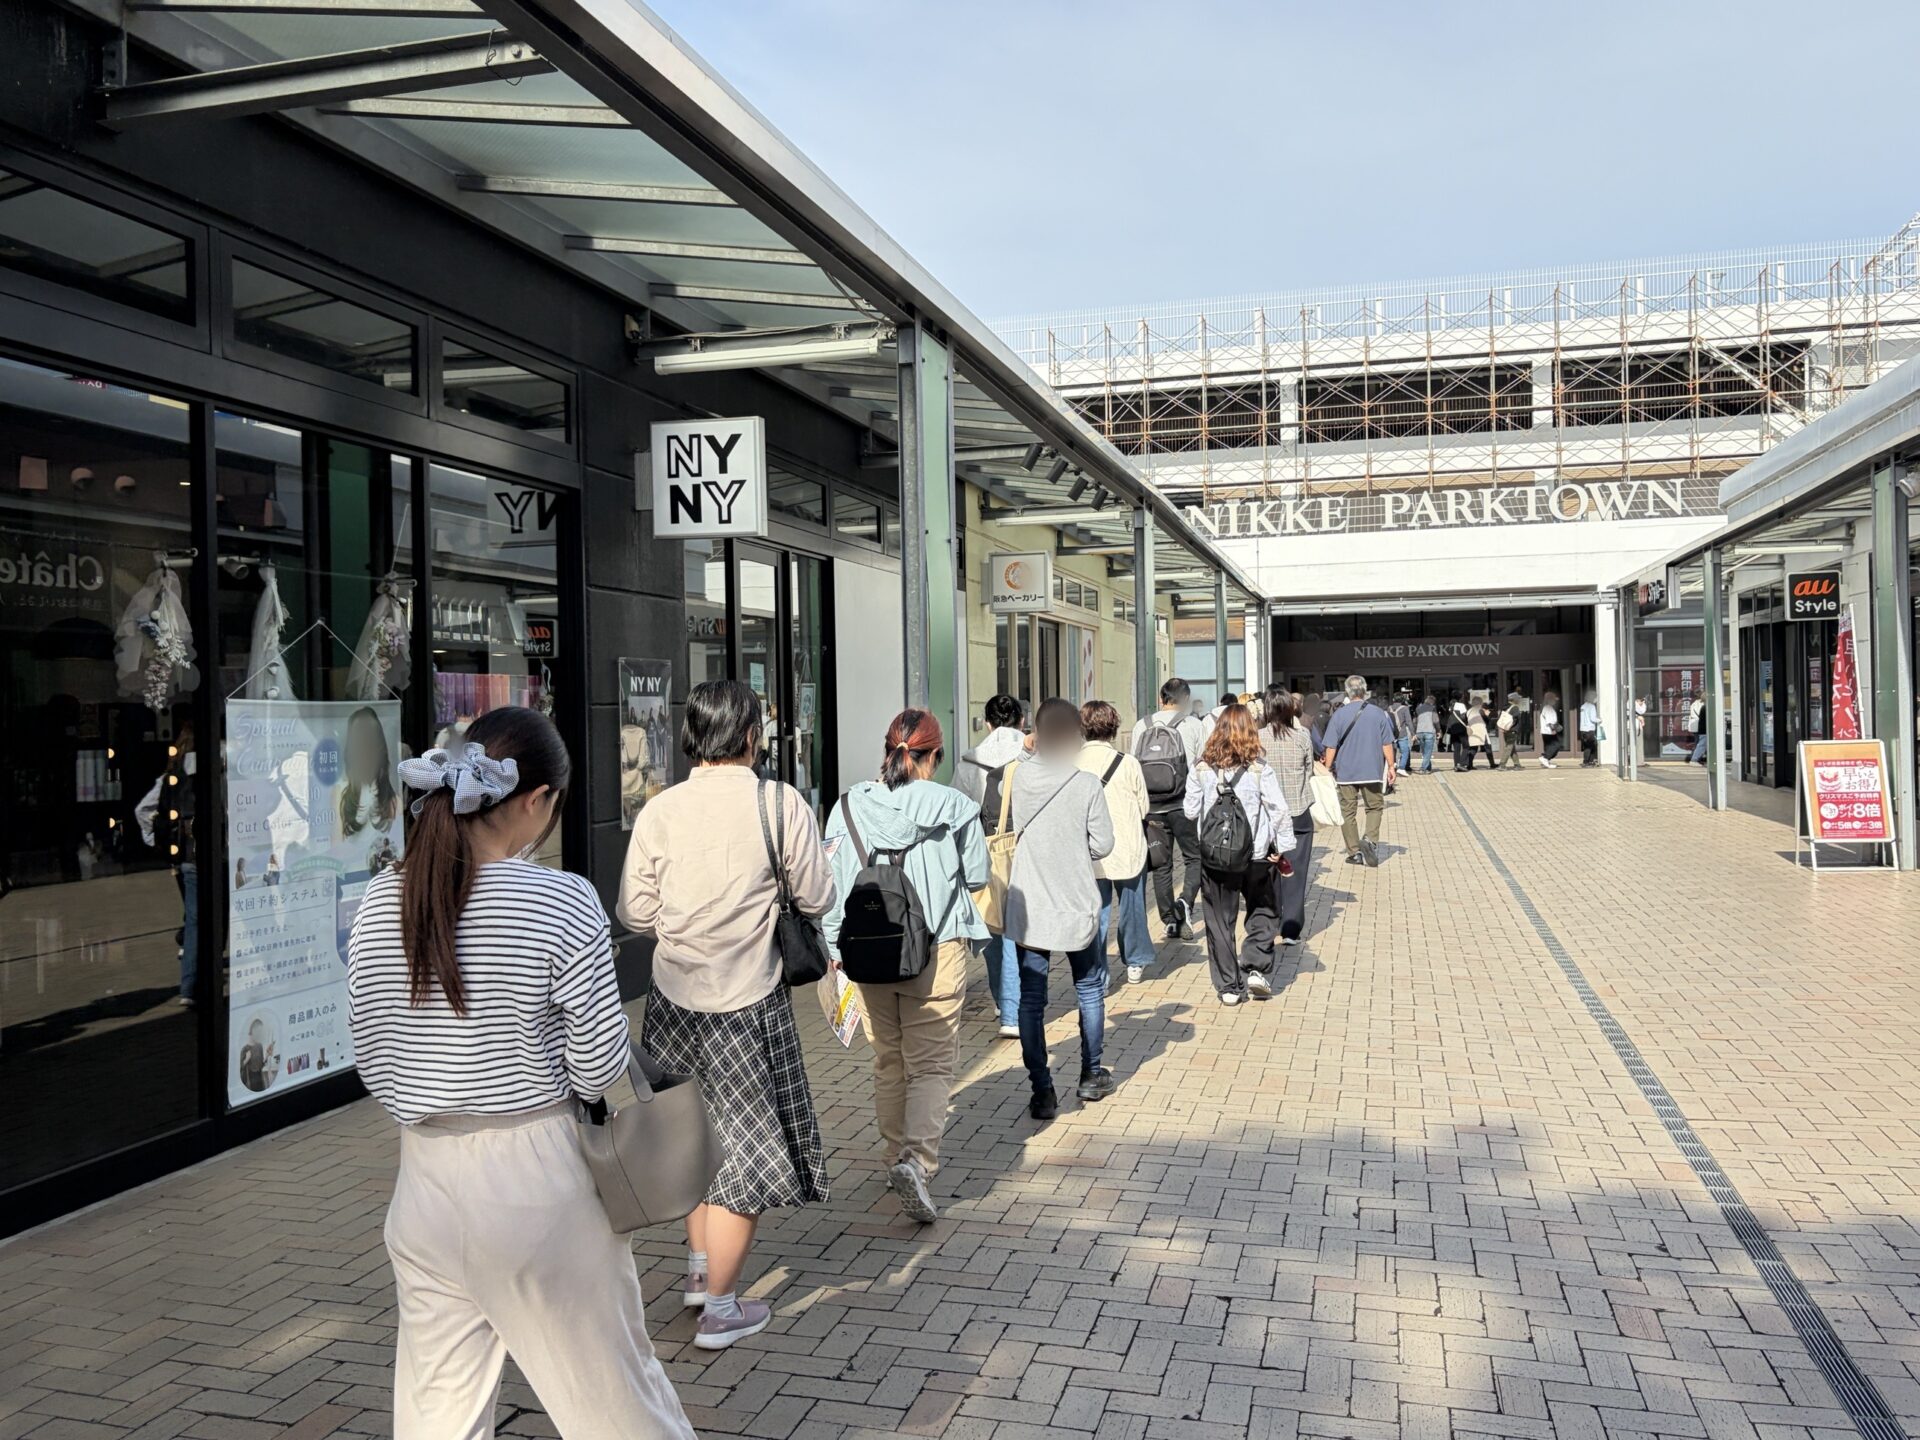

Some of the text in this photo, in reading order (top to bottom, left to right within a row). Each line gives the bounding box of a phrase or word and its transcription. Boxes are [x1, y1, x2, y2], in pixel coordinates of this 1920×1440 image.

[667, 433, 742, 478] NY
[670, 480, 747, 524] NY
[1185, 478, 1684, 538] NIKKE PARKTOWN
[1794, 579, 1836, 596] au
[993, 594, 1044, 603] 阪急ベーカリー
[1795, 598, 1837, 613] Style
[1353, 643, 1500, 659] NIKKE PARKTOWN
[630, 677, 661, 692] NY NY
[1842, 768, 1875, 781] 早いと
[236, 793, 257, 806] Cut
[236, 821, 257, 833] Cut
